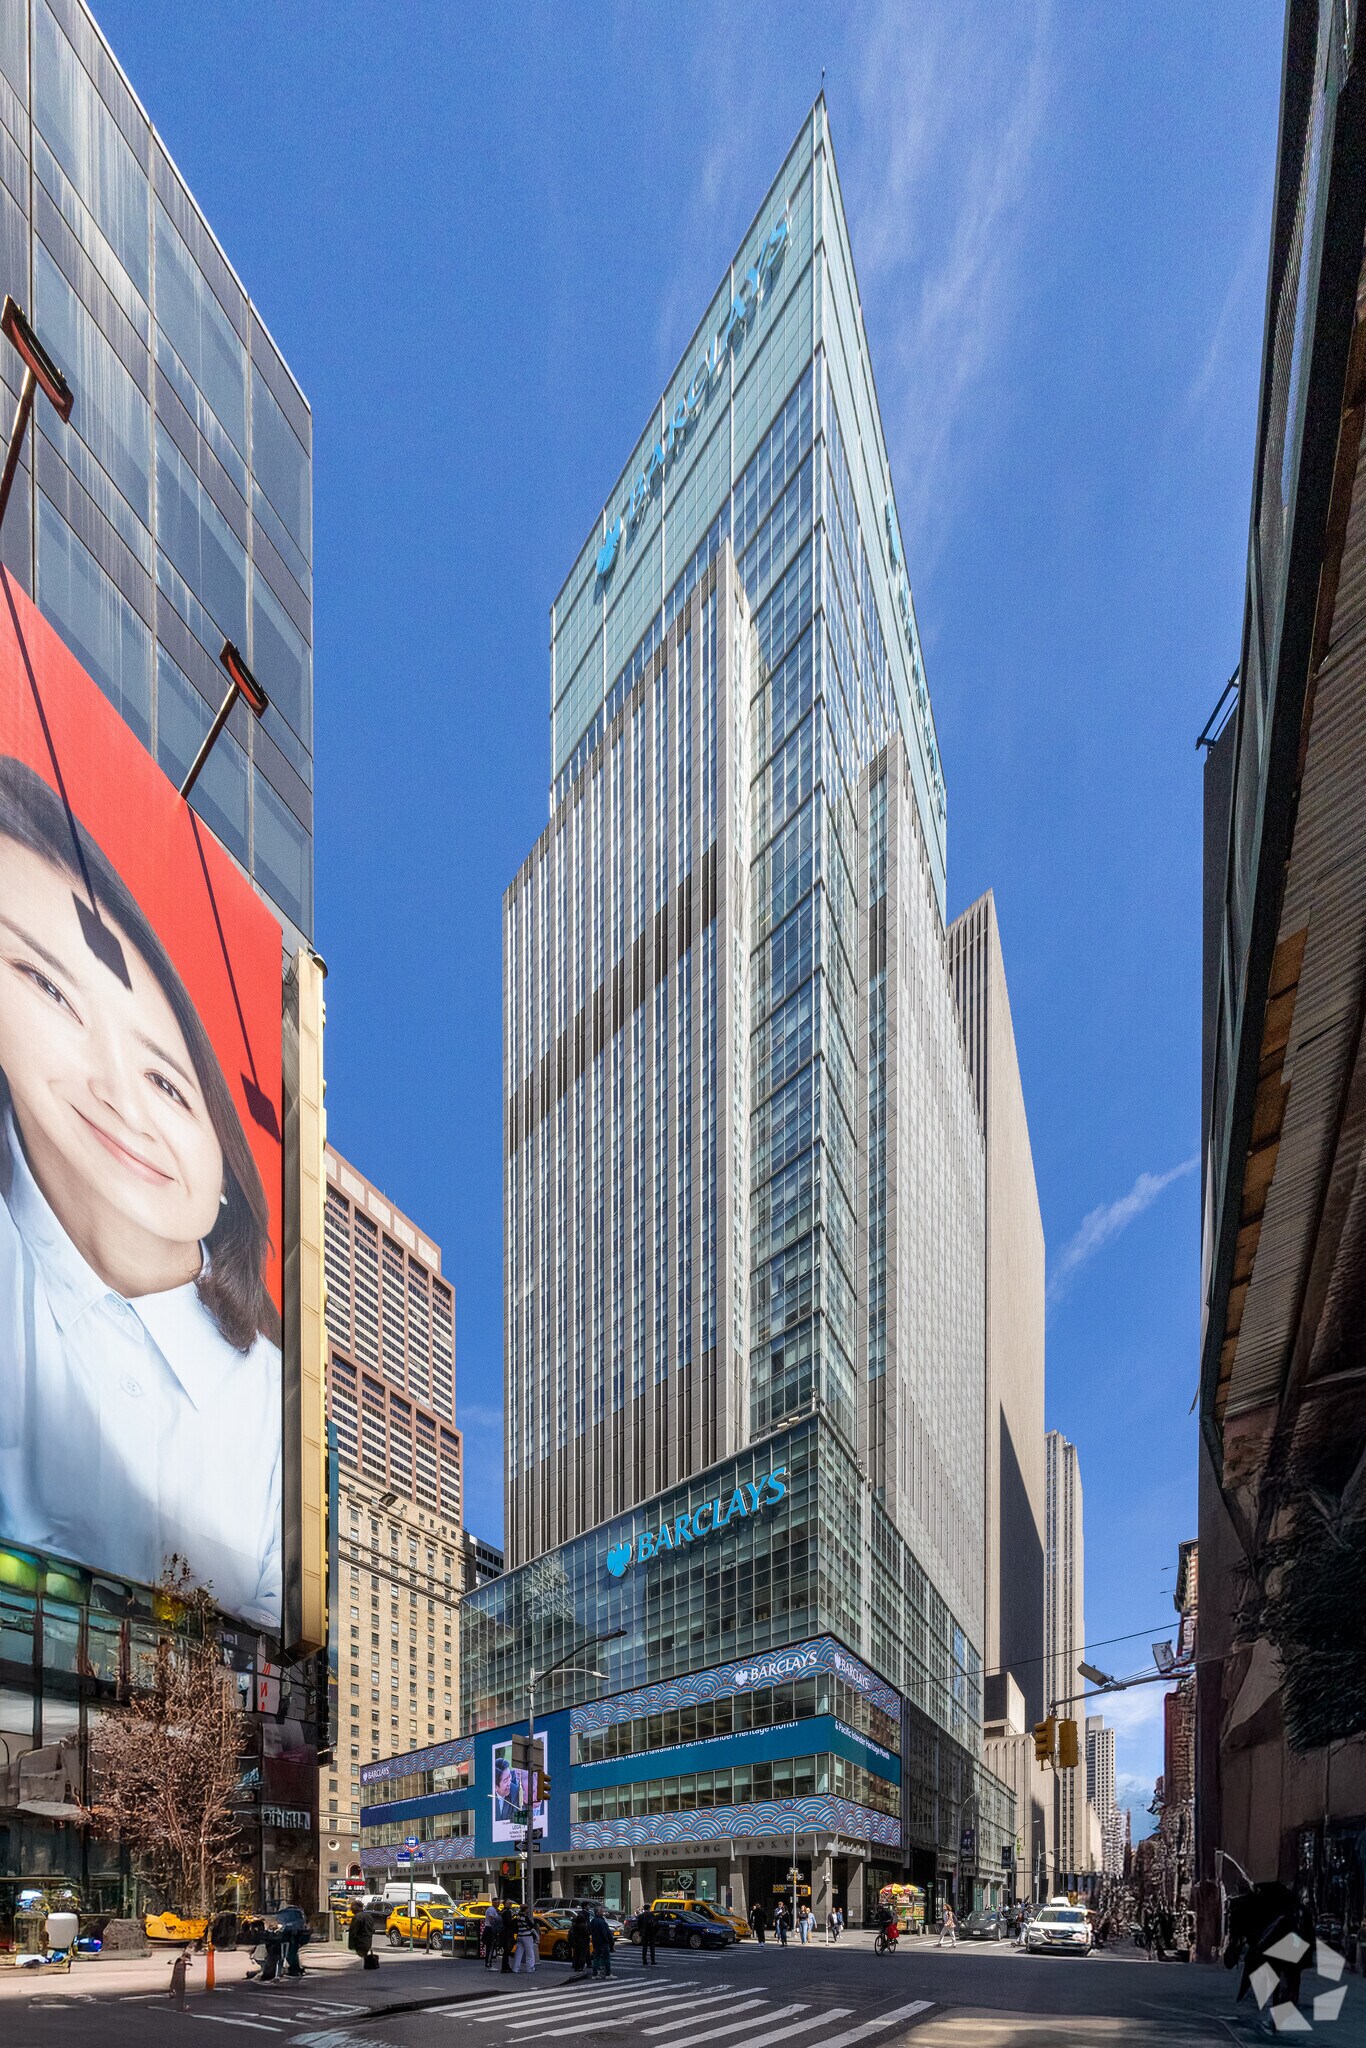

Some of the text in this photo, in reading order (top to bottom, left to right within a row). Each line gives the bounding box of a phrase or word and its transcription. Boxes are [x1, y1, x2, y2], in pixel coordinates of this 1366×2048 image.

[629, 203, 789, 518] BARCLAYS
[638, 1467, 788, 1563] BARCLAYS
[751, 1651, 818, 1681] BARCLAYS
[841, 1660, 869, 1690] BARCLAYS
[367, 1766, 390, 1780] BARCLAYS
[644, 1843, 721, 1858] HONG KONG
[746, 1838, 805, 1850] TOKYO
